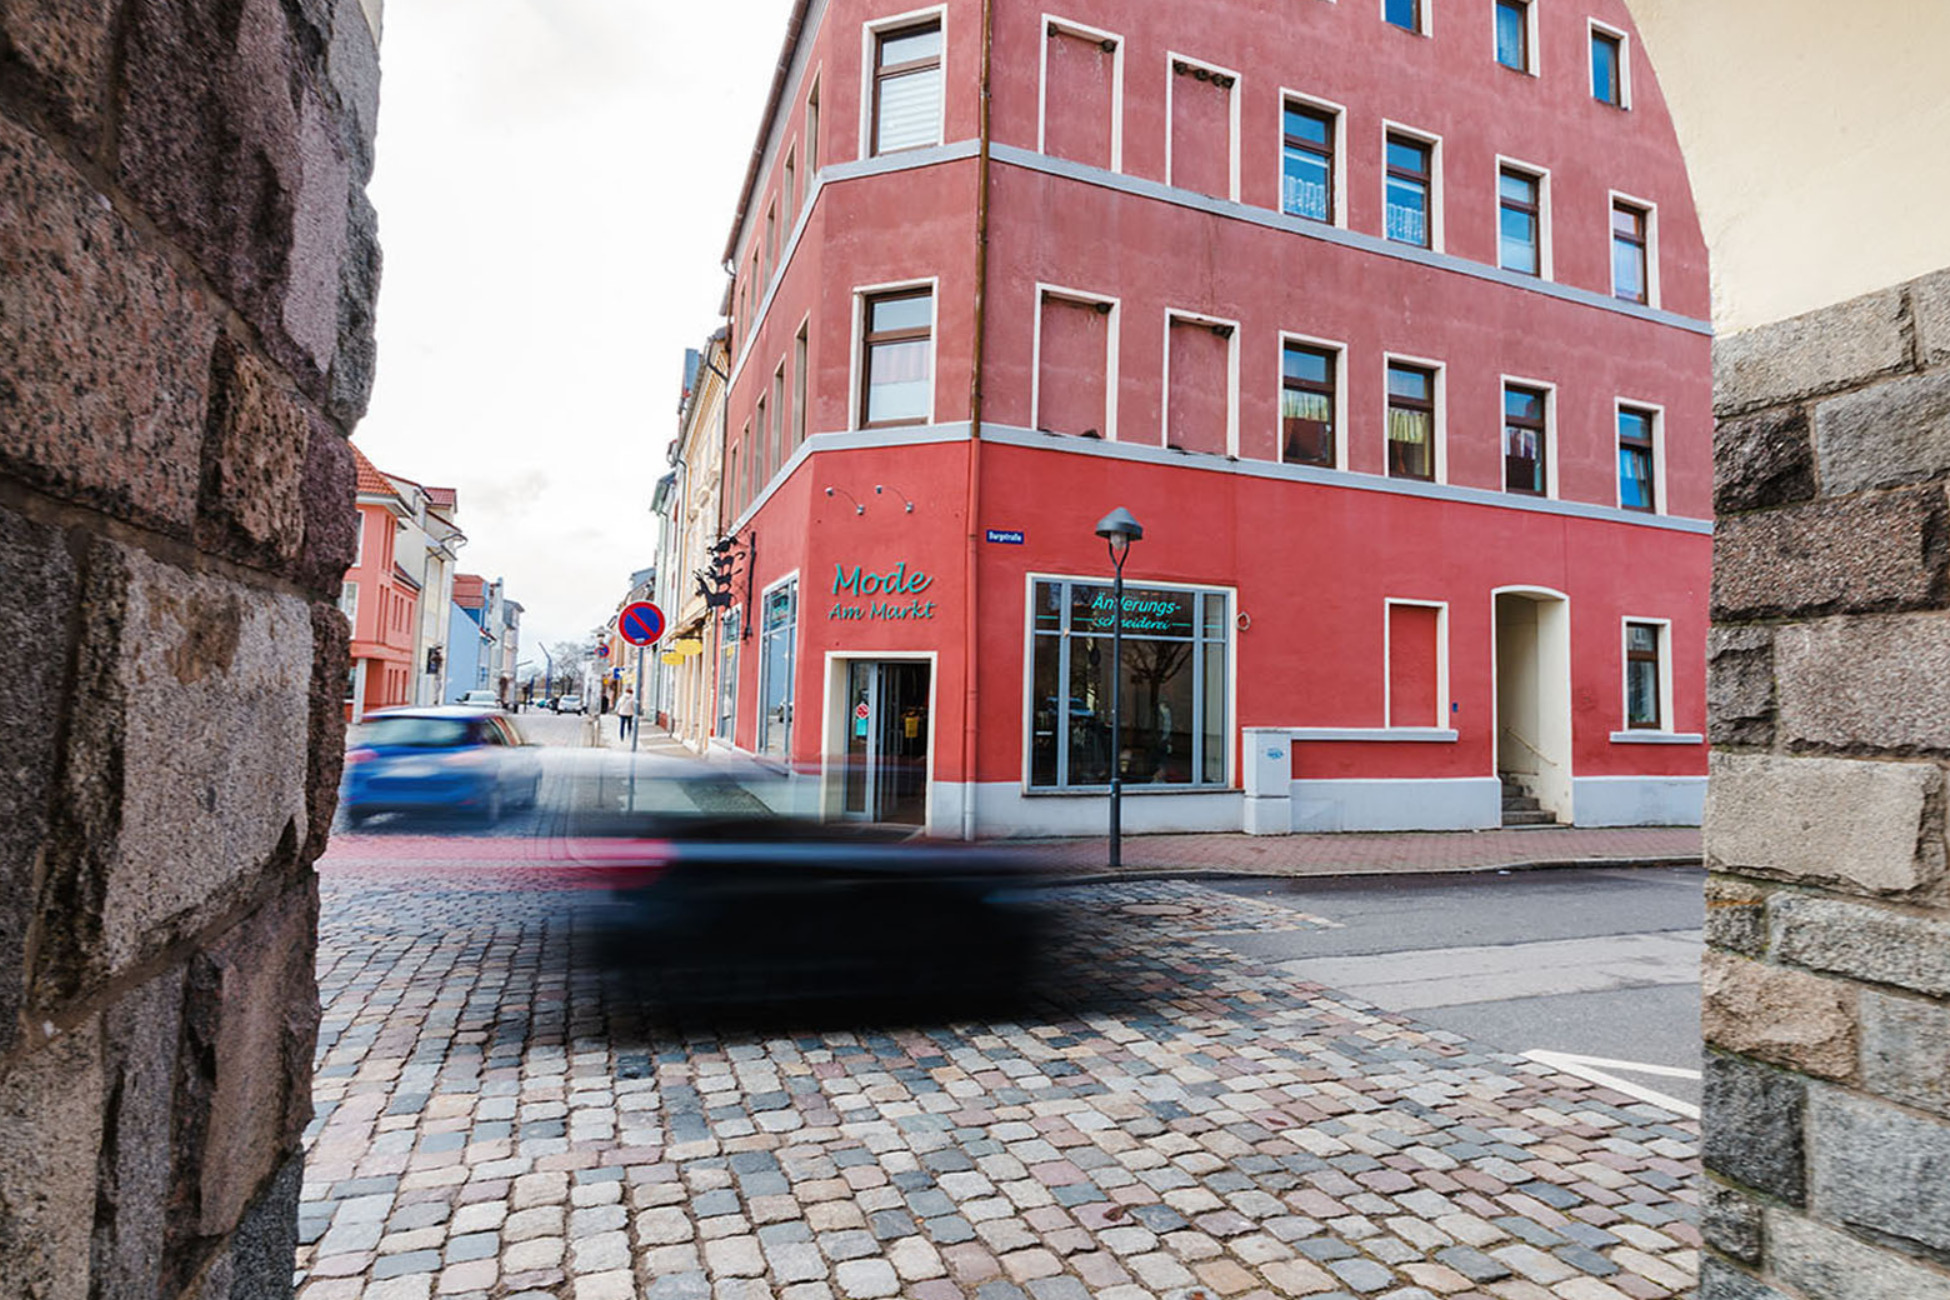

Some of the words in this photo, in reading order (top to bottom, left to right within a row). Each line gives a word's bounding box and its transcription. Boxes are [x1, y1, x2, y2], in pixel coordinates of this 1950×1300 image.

[832, 562, 933, 595] Mode
[828, 603, 865, 620] Am
[869, 600, 936, 620] Markt
